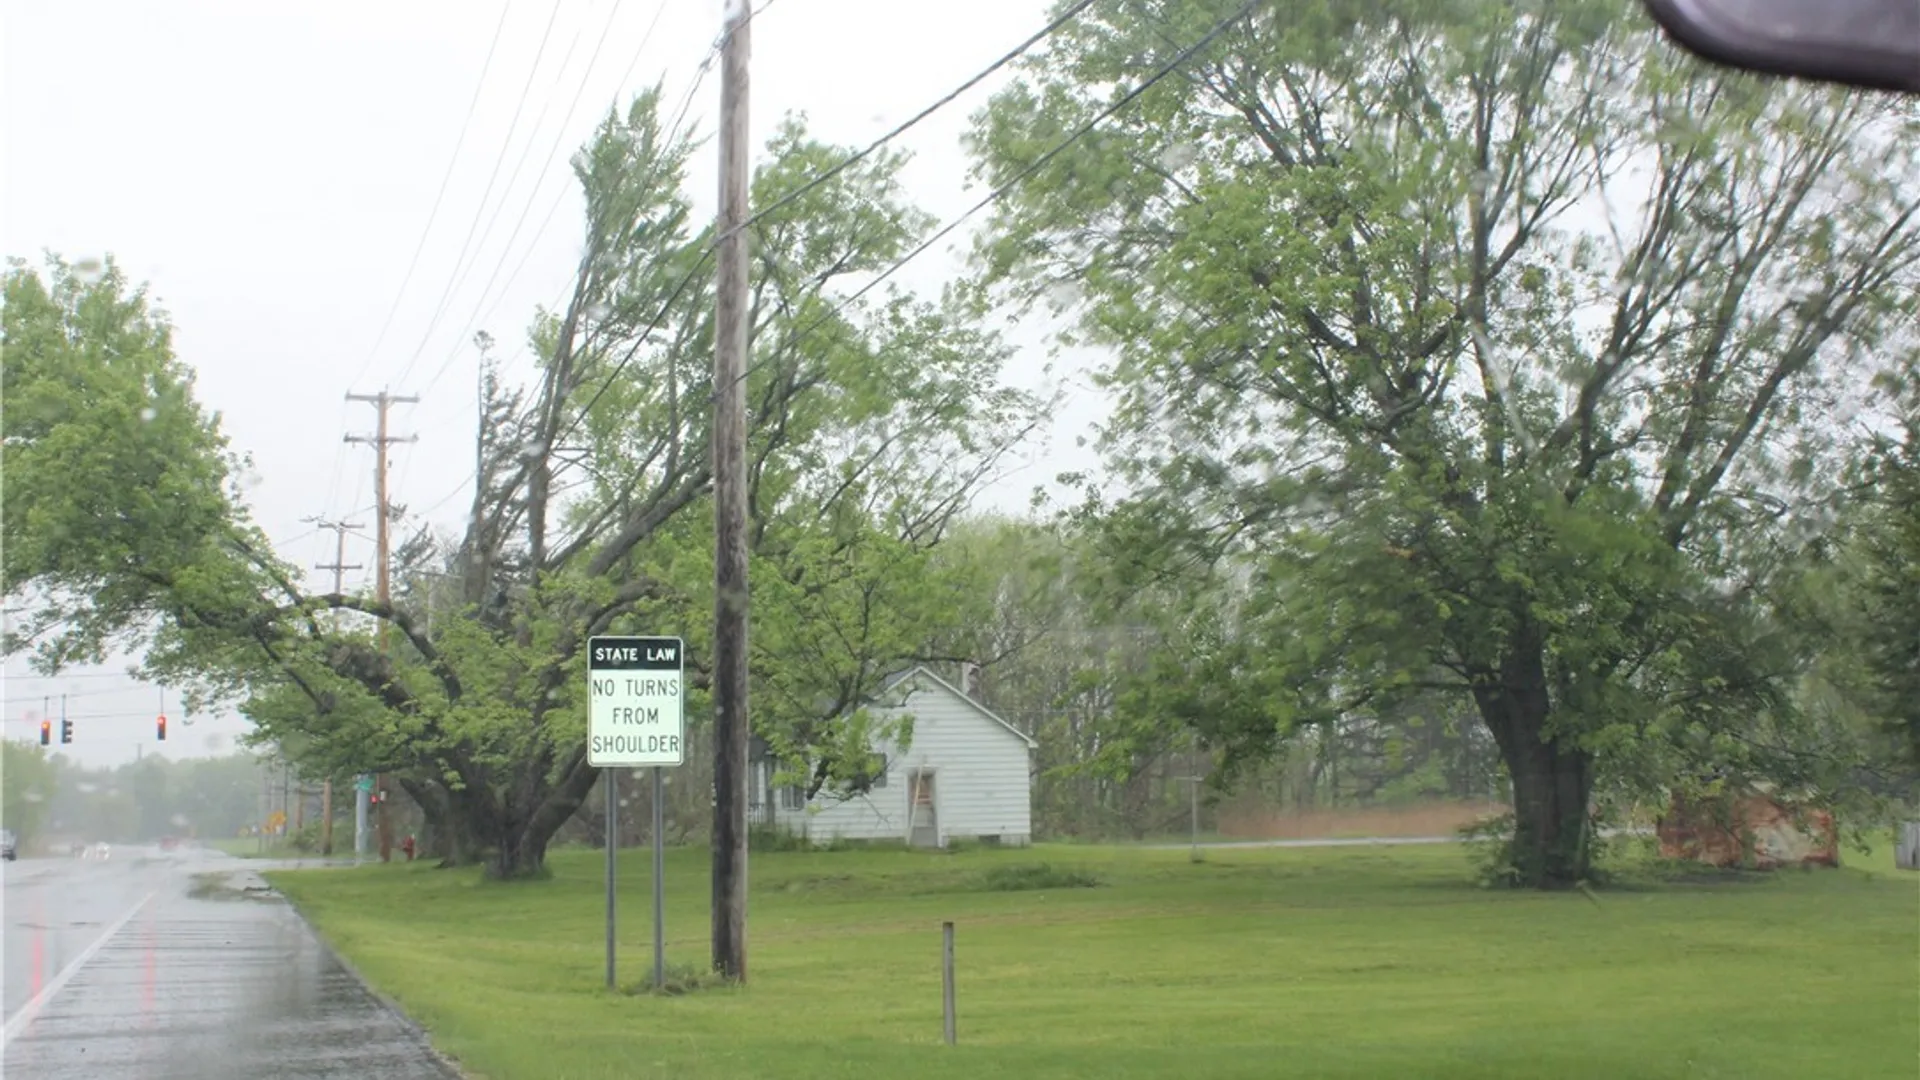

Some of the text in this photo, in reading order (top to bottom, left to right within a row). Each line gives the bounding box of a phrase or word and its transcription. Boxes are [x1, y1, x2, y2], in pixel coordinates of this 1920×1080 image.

[595, 648, 676, 661] STATE LAW
[593, 679, 679, 697] NO TURNS
[612, 707, 659, 725] FROM
[592, 735, 679, 753] SHOULDER
